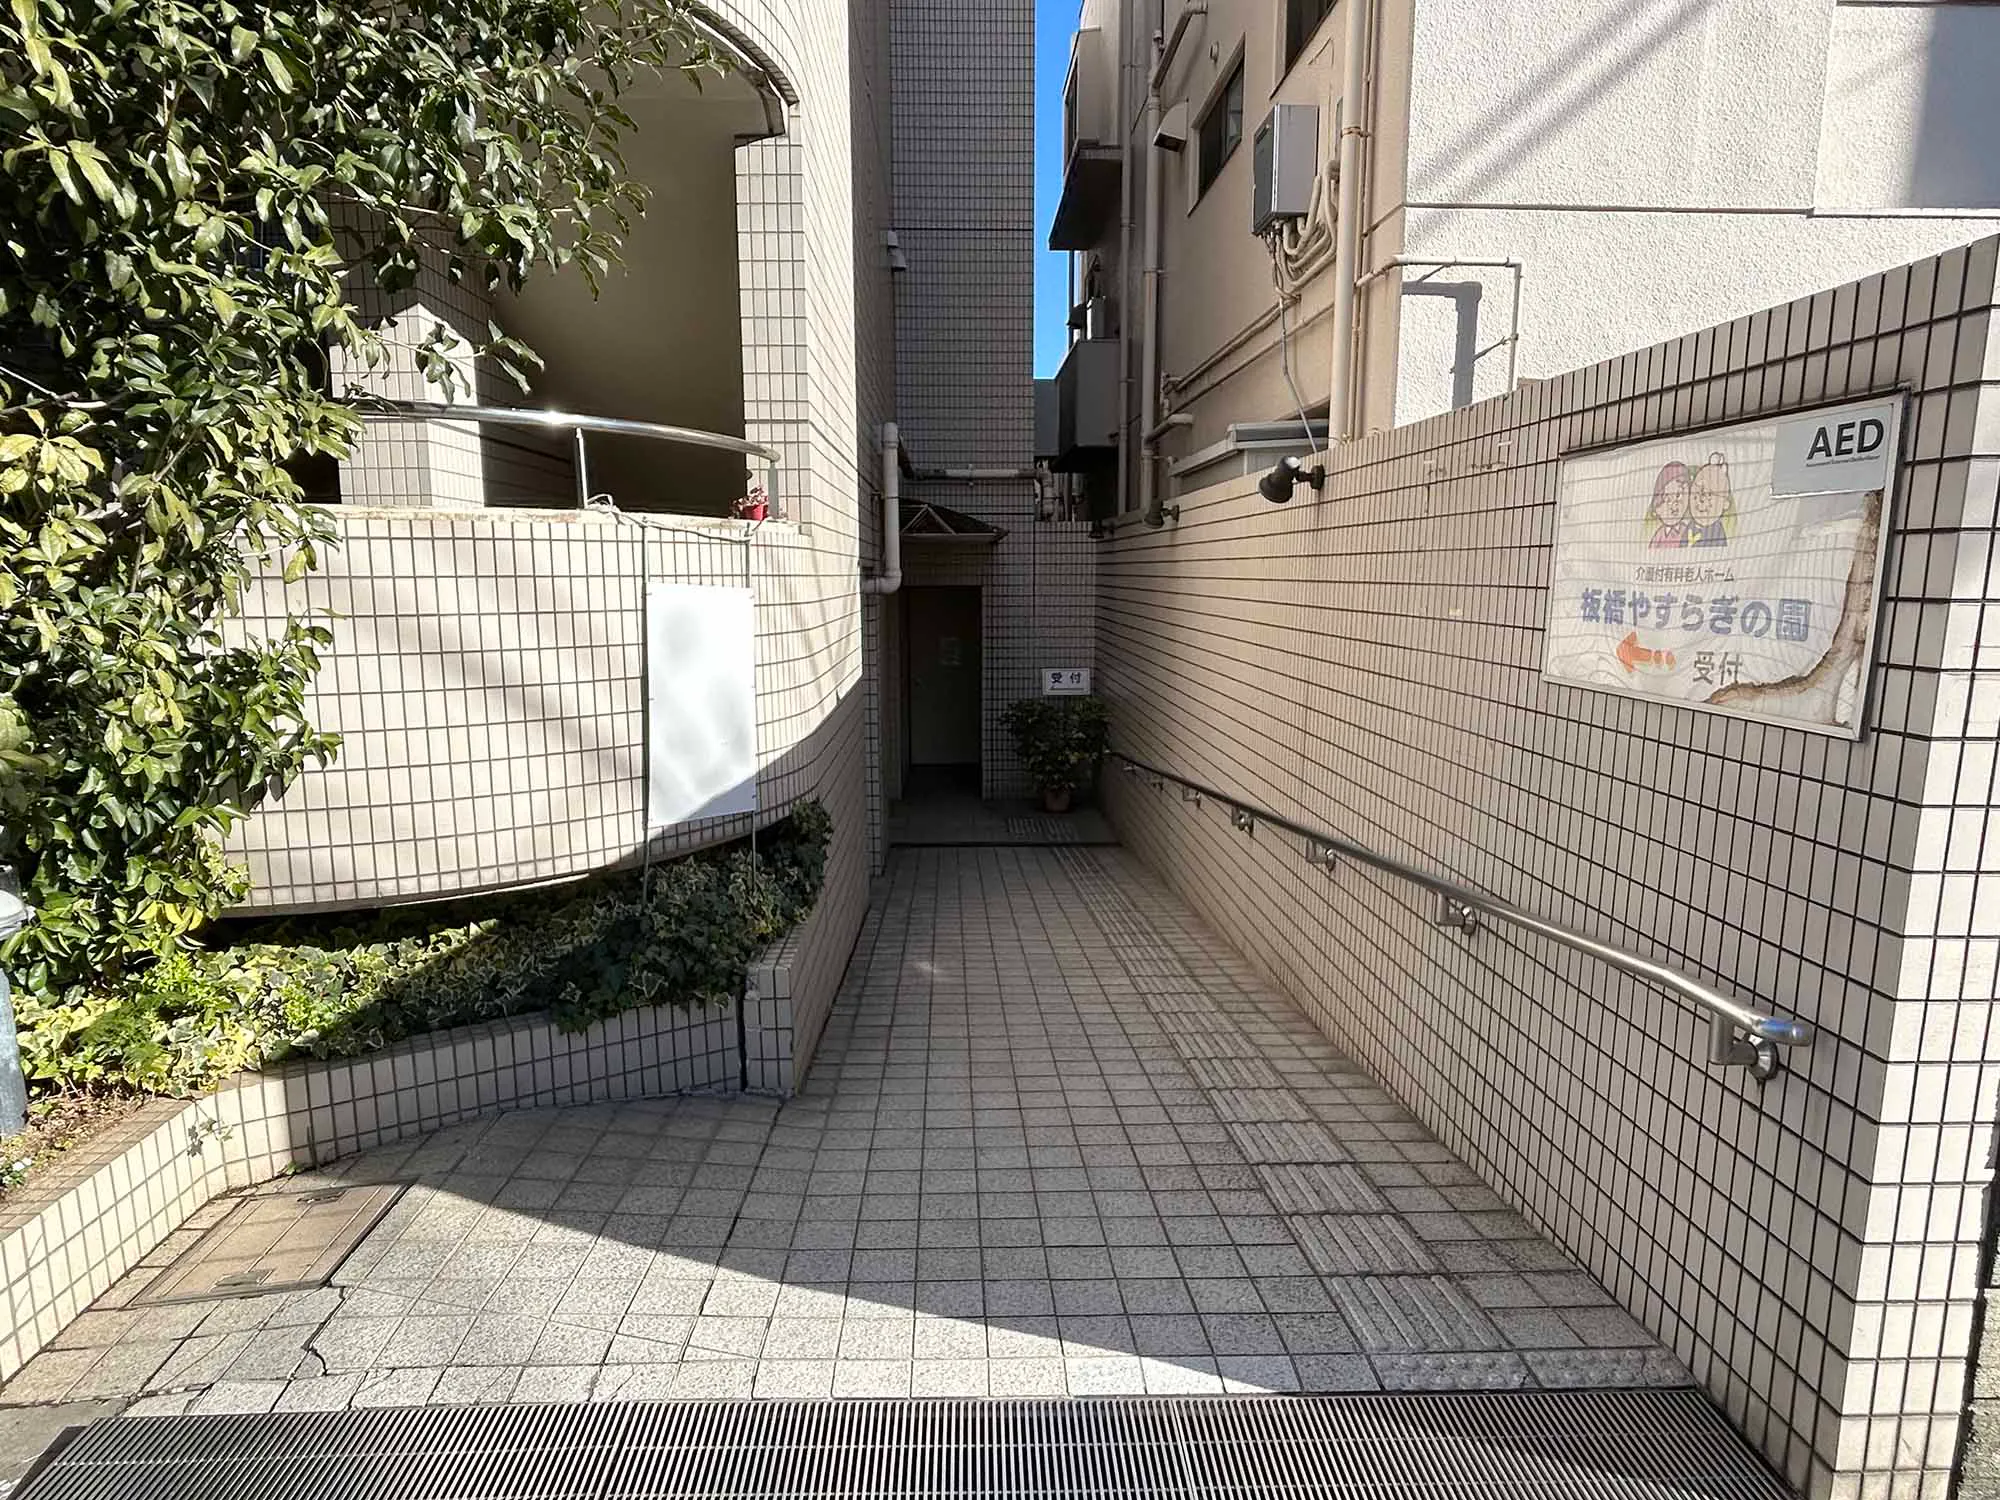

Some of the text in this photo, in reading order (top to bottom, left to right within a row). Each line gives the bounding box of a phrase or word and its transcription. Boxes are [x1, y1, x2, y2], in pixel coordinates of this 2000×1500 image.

[1806, 418, 1884, 460] AED
[1580, 586, 1812, 642] 板橋やすらぎの園
[1051, 671, 1081, 684] 受付
[1693, 650, 1743, 685] 受付
